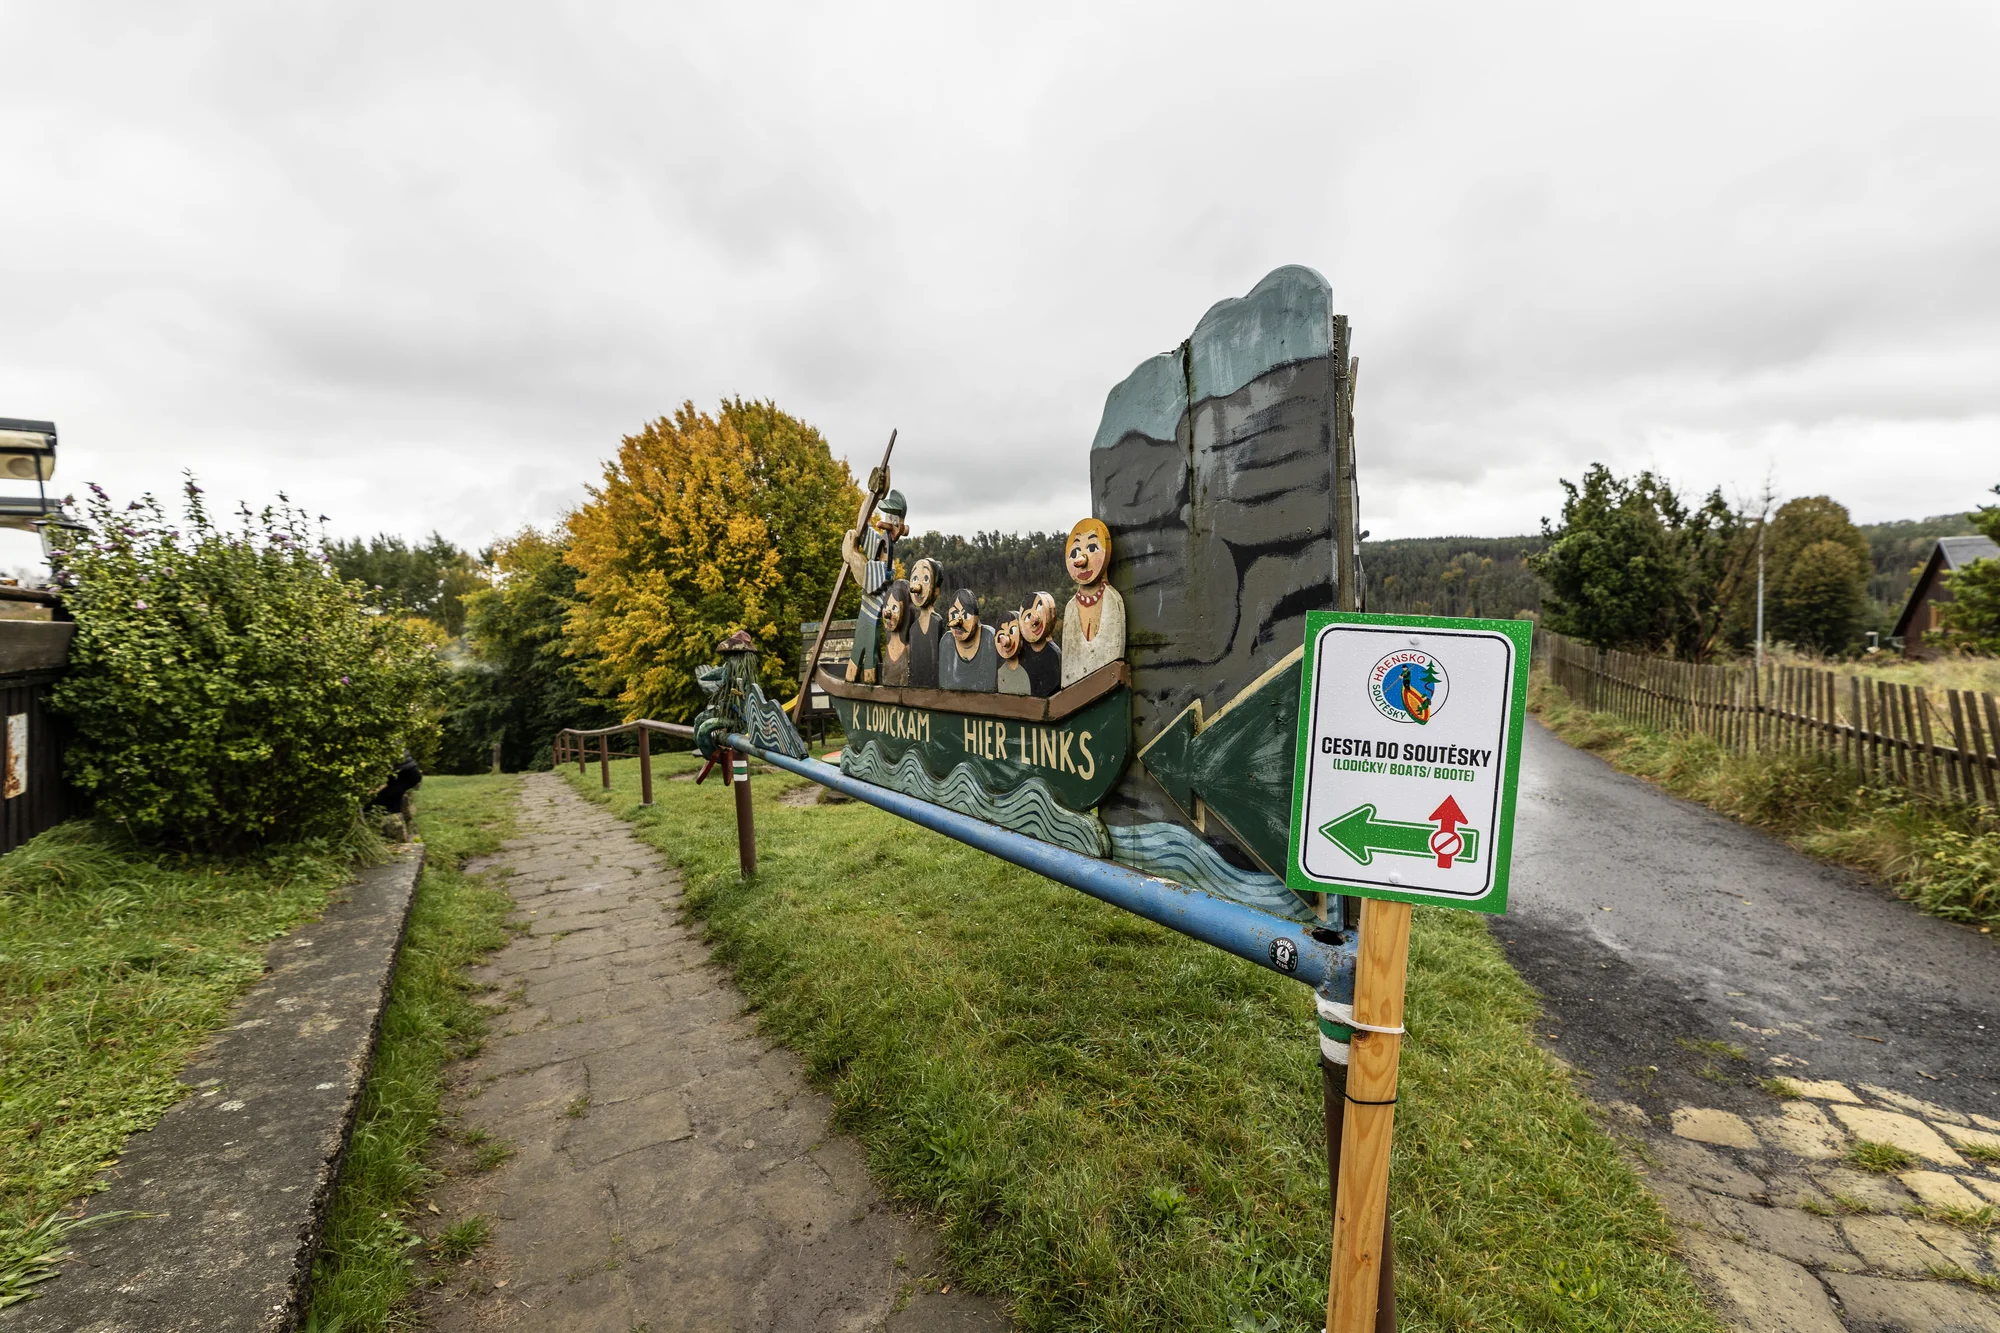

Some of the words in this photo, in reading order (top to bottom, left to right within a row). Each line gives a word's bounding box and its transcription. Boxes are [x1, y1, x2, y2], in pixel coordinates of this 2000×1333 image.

[852, 702, 860, 730] K
[866, 705, 930, 743] LODICKAM
[963, 718, 1008, 761] HIER
[1020, 726, 1095, 781] LINKS
[1321, 736, 1371, 757] CESTA
[1375, 741, 1399, 760] DO
[1402, 743, 1492, 768] SOUTĚSKY
[1434, 767, 1475, 782] BOOTE)
